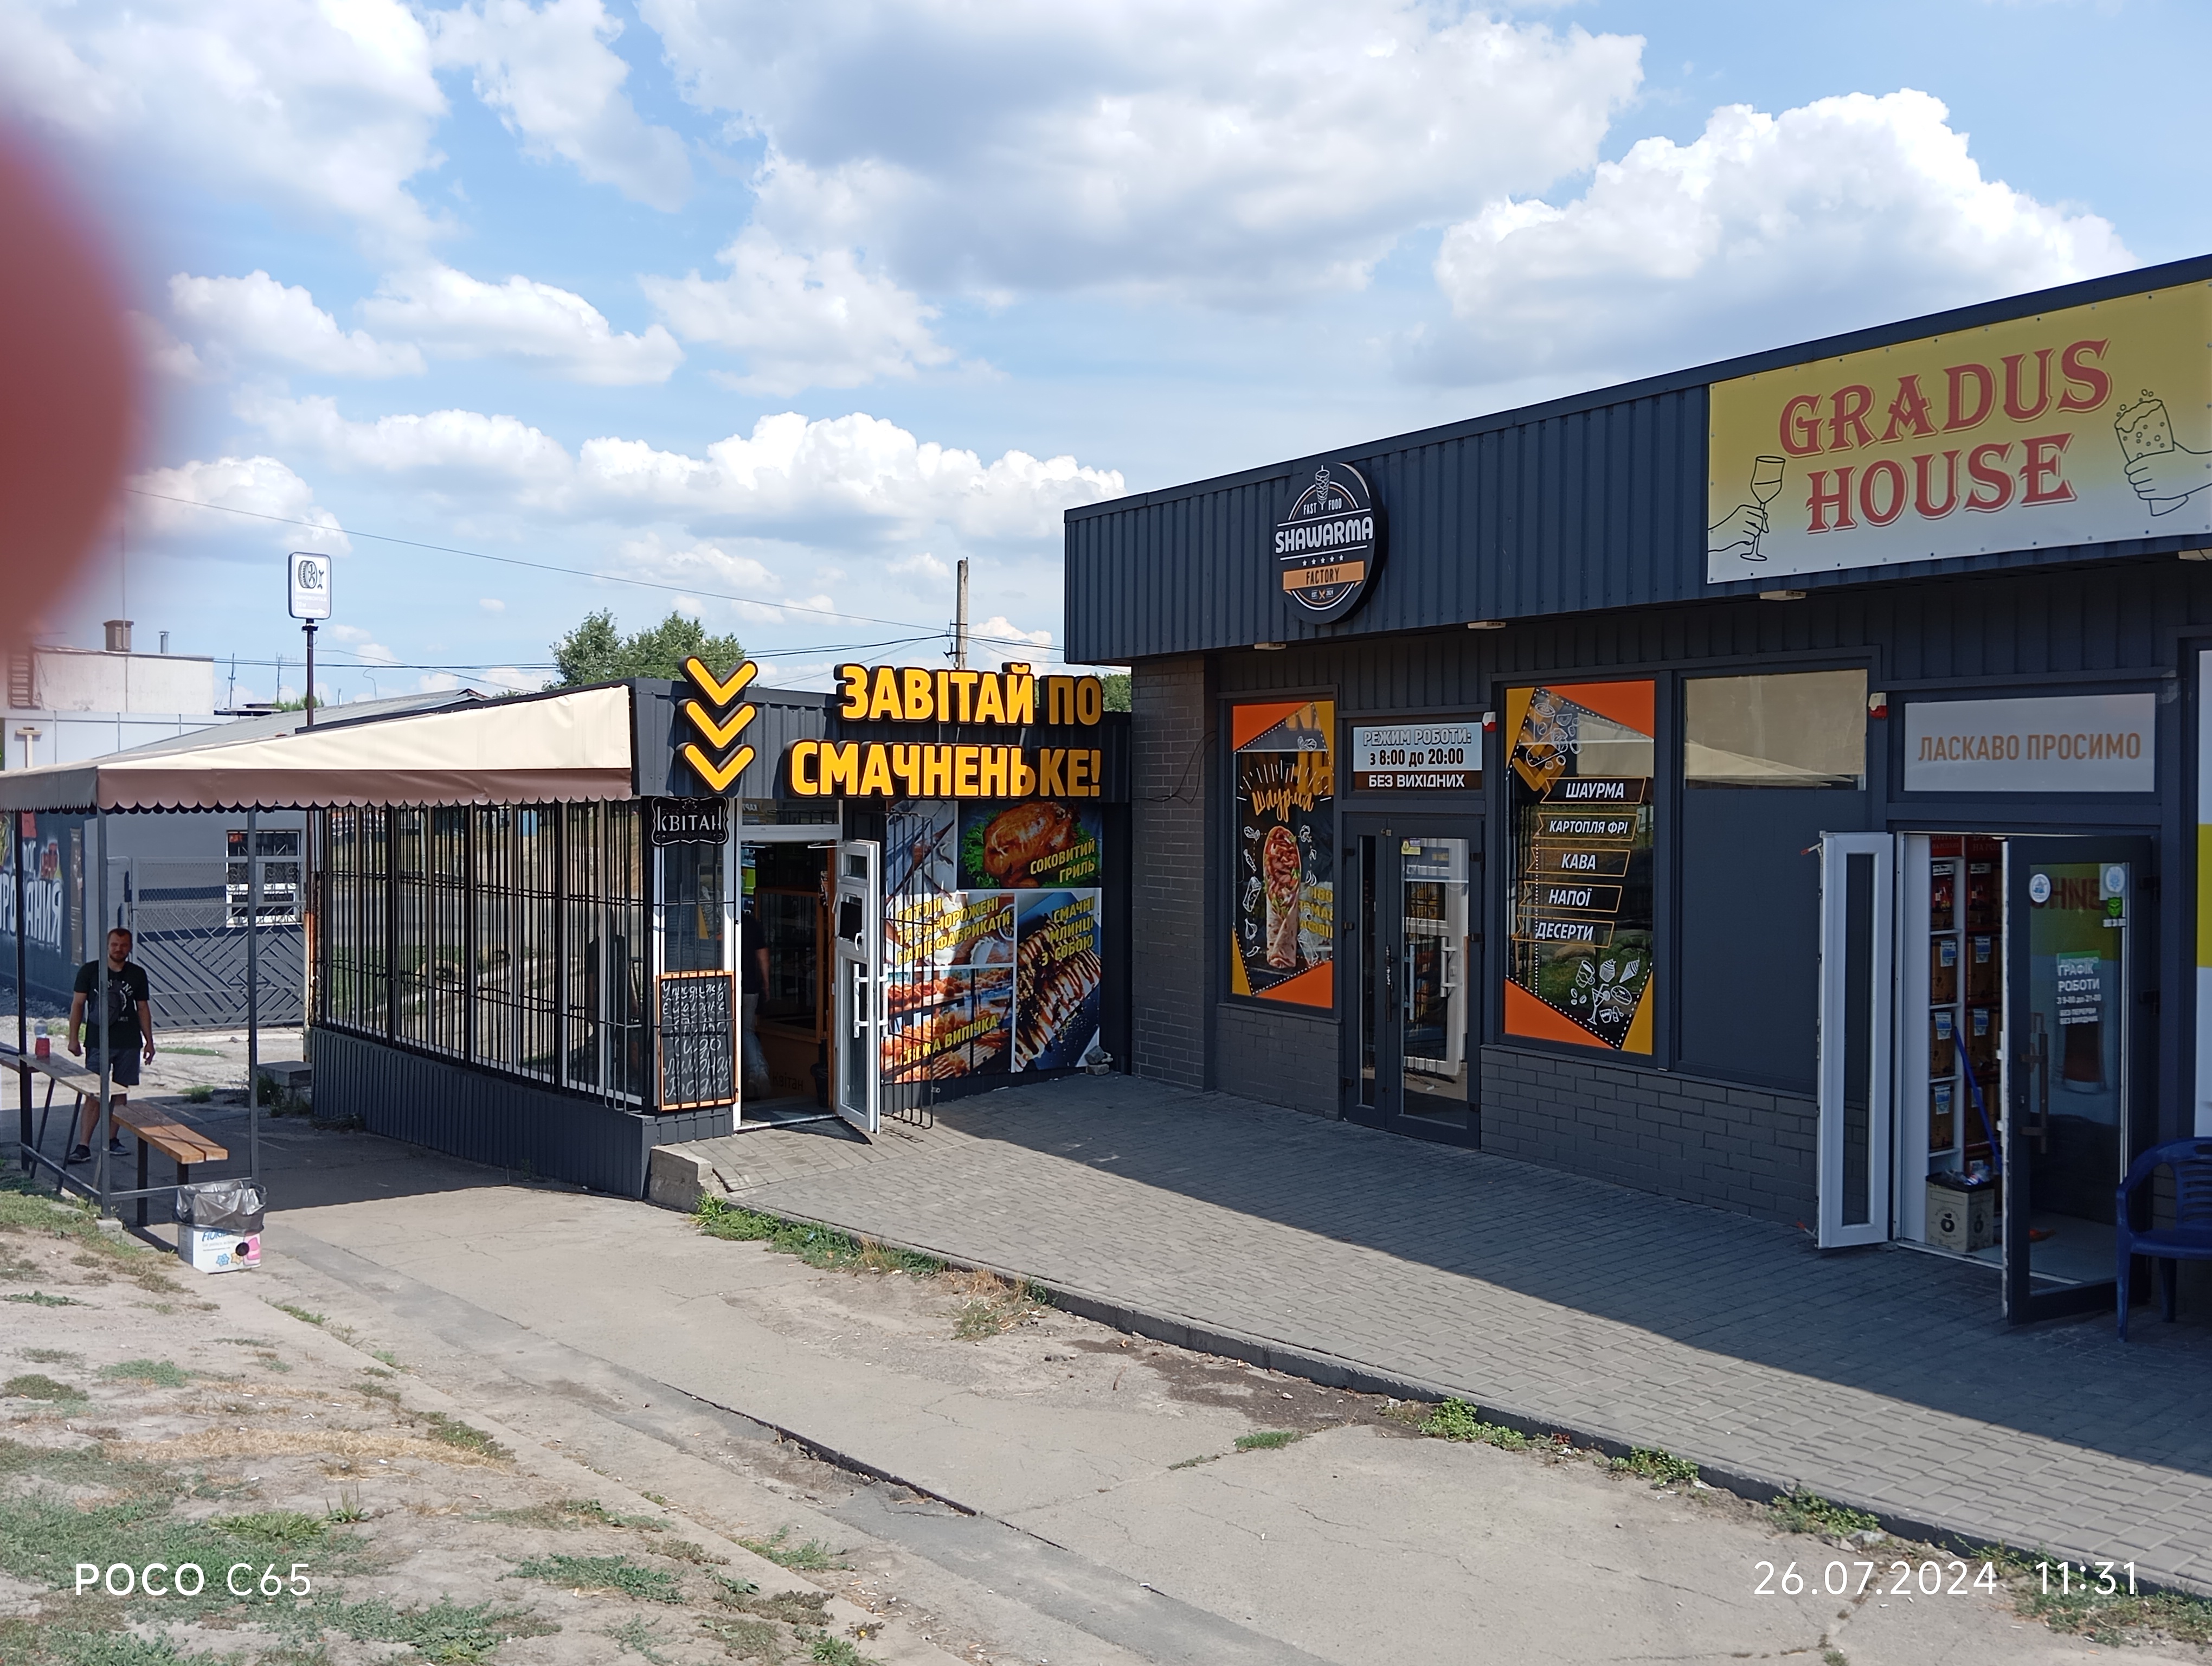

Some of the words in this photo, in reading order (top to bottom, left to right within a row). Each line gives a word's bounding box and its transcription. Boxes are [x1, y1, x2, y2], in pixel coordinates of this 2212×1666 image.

[1779, 337, 2112, 458] GRADUS
[1806, 433, 2078, 535] HOUSE
[1303, 502, 1317, 515] FAST
[1328, 498, 1342, 510] FOOD
[1275, 516, 1373, 553] SHAWARMA
[1306, 567, 1340, 585] FACTORY
[838, 662, 1035, 724] ЗАВІТАЙ
[1048, 676, 1102, 726] ПО
[1364, 731, 1411, 746] РЕЖИМ
[1414, 728, 1471, 745] РОБОТИ:
[1918, 735, 2020, 761] ЛАСКАВО
[2027, 733, 2141, 760] ПРОСИМО
[789, 740, 1102, 798] СМАЧНЕНЬКЕ!
[1379, 749, 1405, 765] 8:00
[1409, 752, 1424, 767] до
[1428, 748, 1464, 765] 20:00
[1368, 774, 1393, 787] БЕЗ
[1397, 774, 1465, 787] ВИХІДНИХ
[1565, 783, 1624, 798] ШАУРМА
[1549, 820, 1605, 833] КАРТОПЛЯ
[1607, 821, 1628, 834] ФРІ
[1030, 837, 1096, 875] СОКОВИТИЙ
[1561, 854, 1596, 870] КАВА
[1059, 860, 1095, 883] ГРИЛЬ
[1053, 896, 1095, 923] СМАЧНІ
[1548, 888, 1592, 906] НАПОЇ
[897, 928, 913, 945] ТА
[917, 896, 999, 938] ЗАМОРОЖЕНІ
[898, 898, 942, 927] ГОТОВІ
[897, 912, 1010, 966] НАПІВФАБРИКАТИ
[1049, 915, 1094, 944] МЛИНЦІ
[1535, 922, 1594, 941] ДЕСЕРТИ
[1041, 952, 1049, 966] З
[1055, 934, 1094, 960] СОБОЮ
[2057, 963, 2093, 976] ГРАФІК
[2057, 978, 2100, 992] РОБОТИ
[945, 1015, 998, 1048] ВИПІЧКА
